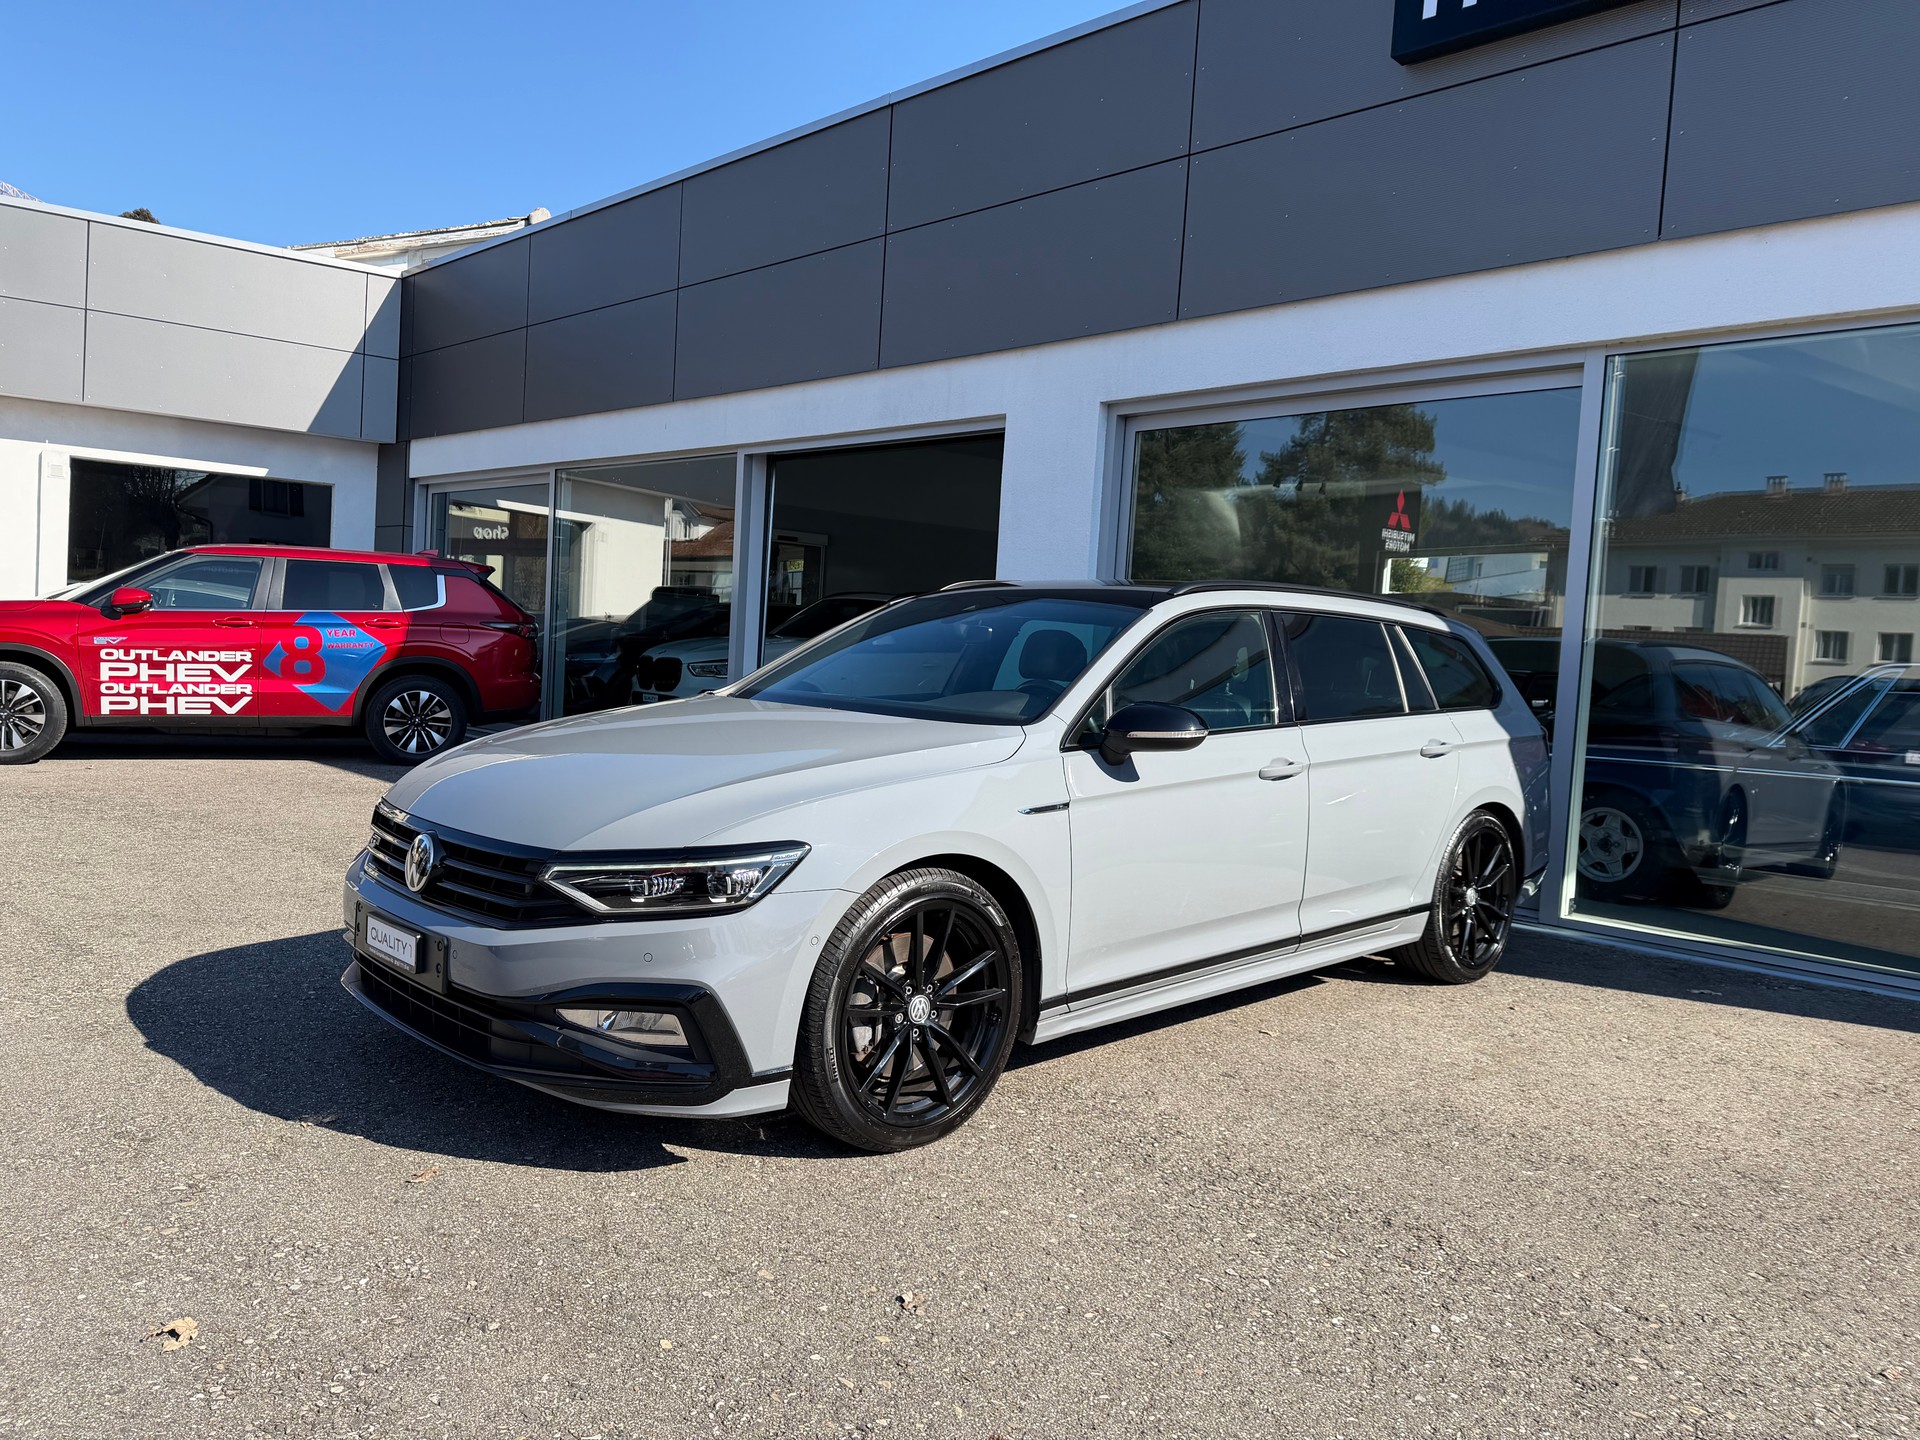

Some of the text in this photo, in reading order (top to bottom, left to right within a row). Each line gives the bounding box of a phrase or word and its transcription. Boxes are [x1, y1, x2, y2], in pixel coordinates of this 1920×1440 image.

[326, 628, 357, 638] YEAR
[326, 642, 375, 650] WARRANTY
[100, 648, 253, 662] OUTLANDER
[279, 624, 327, 687] 8
[100, 662, 253, 682] PHEV
[100, 683, 253, 695] OUTLANDER
[100, 696, 253, 715] PHEV
[371, 926, 408, 955] QUALITY
